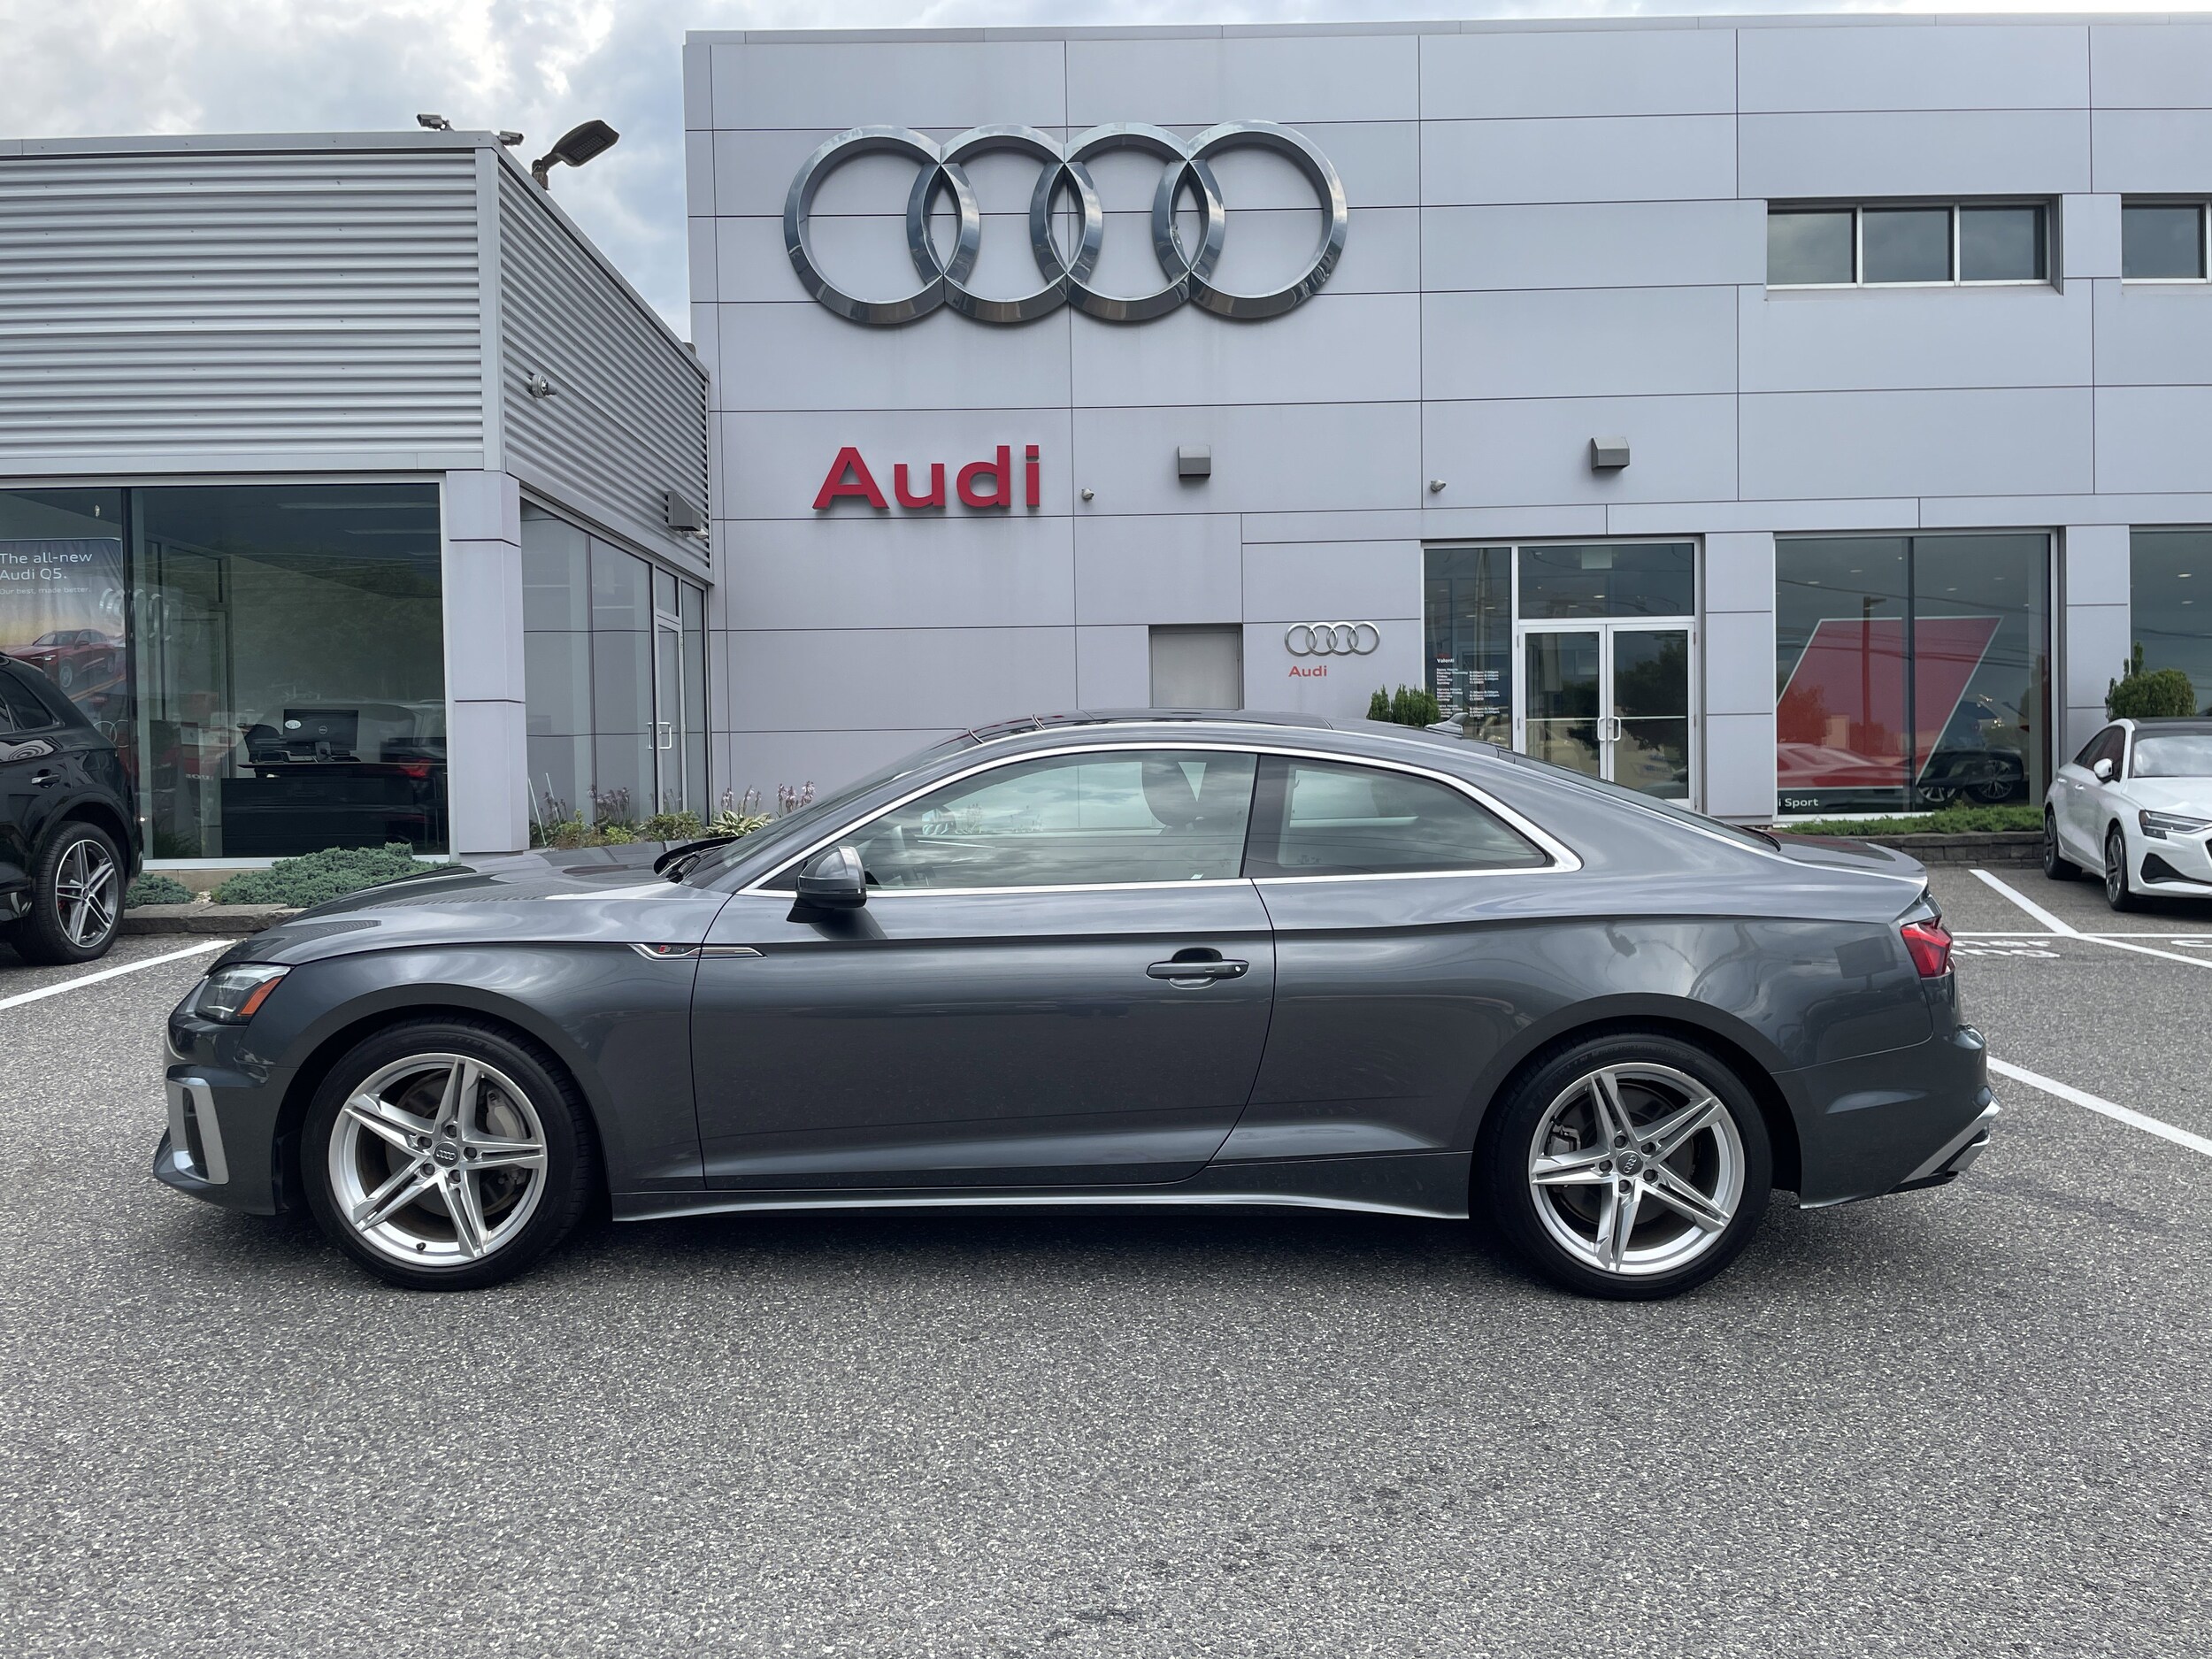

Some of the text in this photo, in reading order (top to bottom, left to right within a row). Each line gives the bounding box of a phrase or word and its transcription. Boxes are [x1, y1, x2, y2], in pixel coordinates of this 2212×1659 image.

[812, 444, 1040, 509] Audi
[0, 552, 93, 564] The all-new
[0, 568, 67, 580] Audi Q5.
[1288, 665, 1327, 677] Audi
[1785, 798, 1819, 808] Sport
